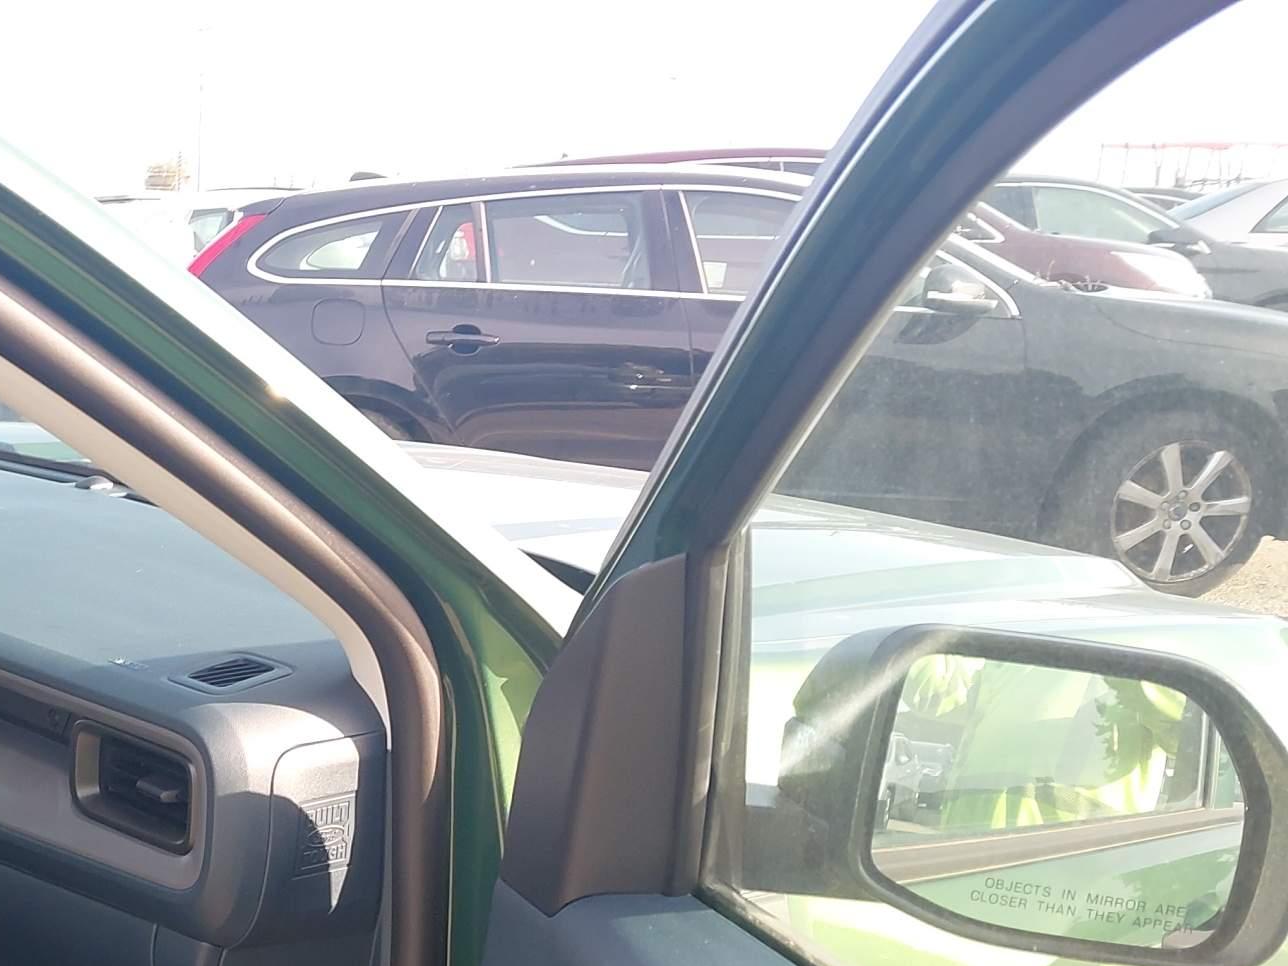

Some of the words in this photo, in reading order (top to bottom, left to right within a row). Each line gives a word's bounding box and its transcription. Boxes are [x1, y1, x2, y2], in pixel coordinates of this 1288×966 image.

[970, 890, 1028, 909] CLOSER
[1037, 901, 1076, 917] THAN
[1087, 908, 1125, 924] THEY
[1132, 916, 1193, 935] APPEAR
[984, 877, 1052, 897] OBJECTS
[1061, 888, 1077, 901] IN
[1086, 892, 1146, 912] MIRROR
[1154, 904, 1186, 917] ARE
